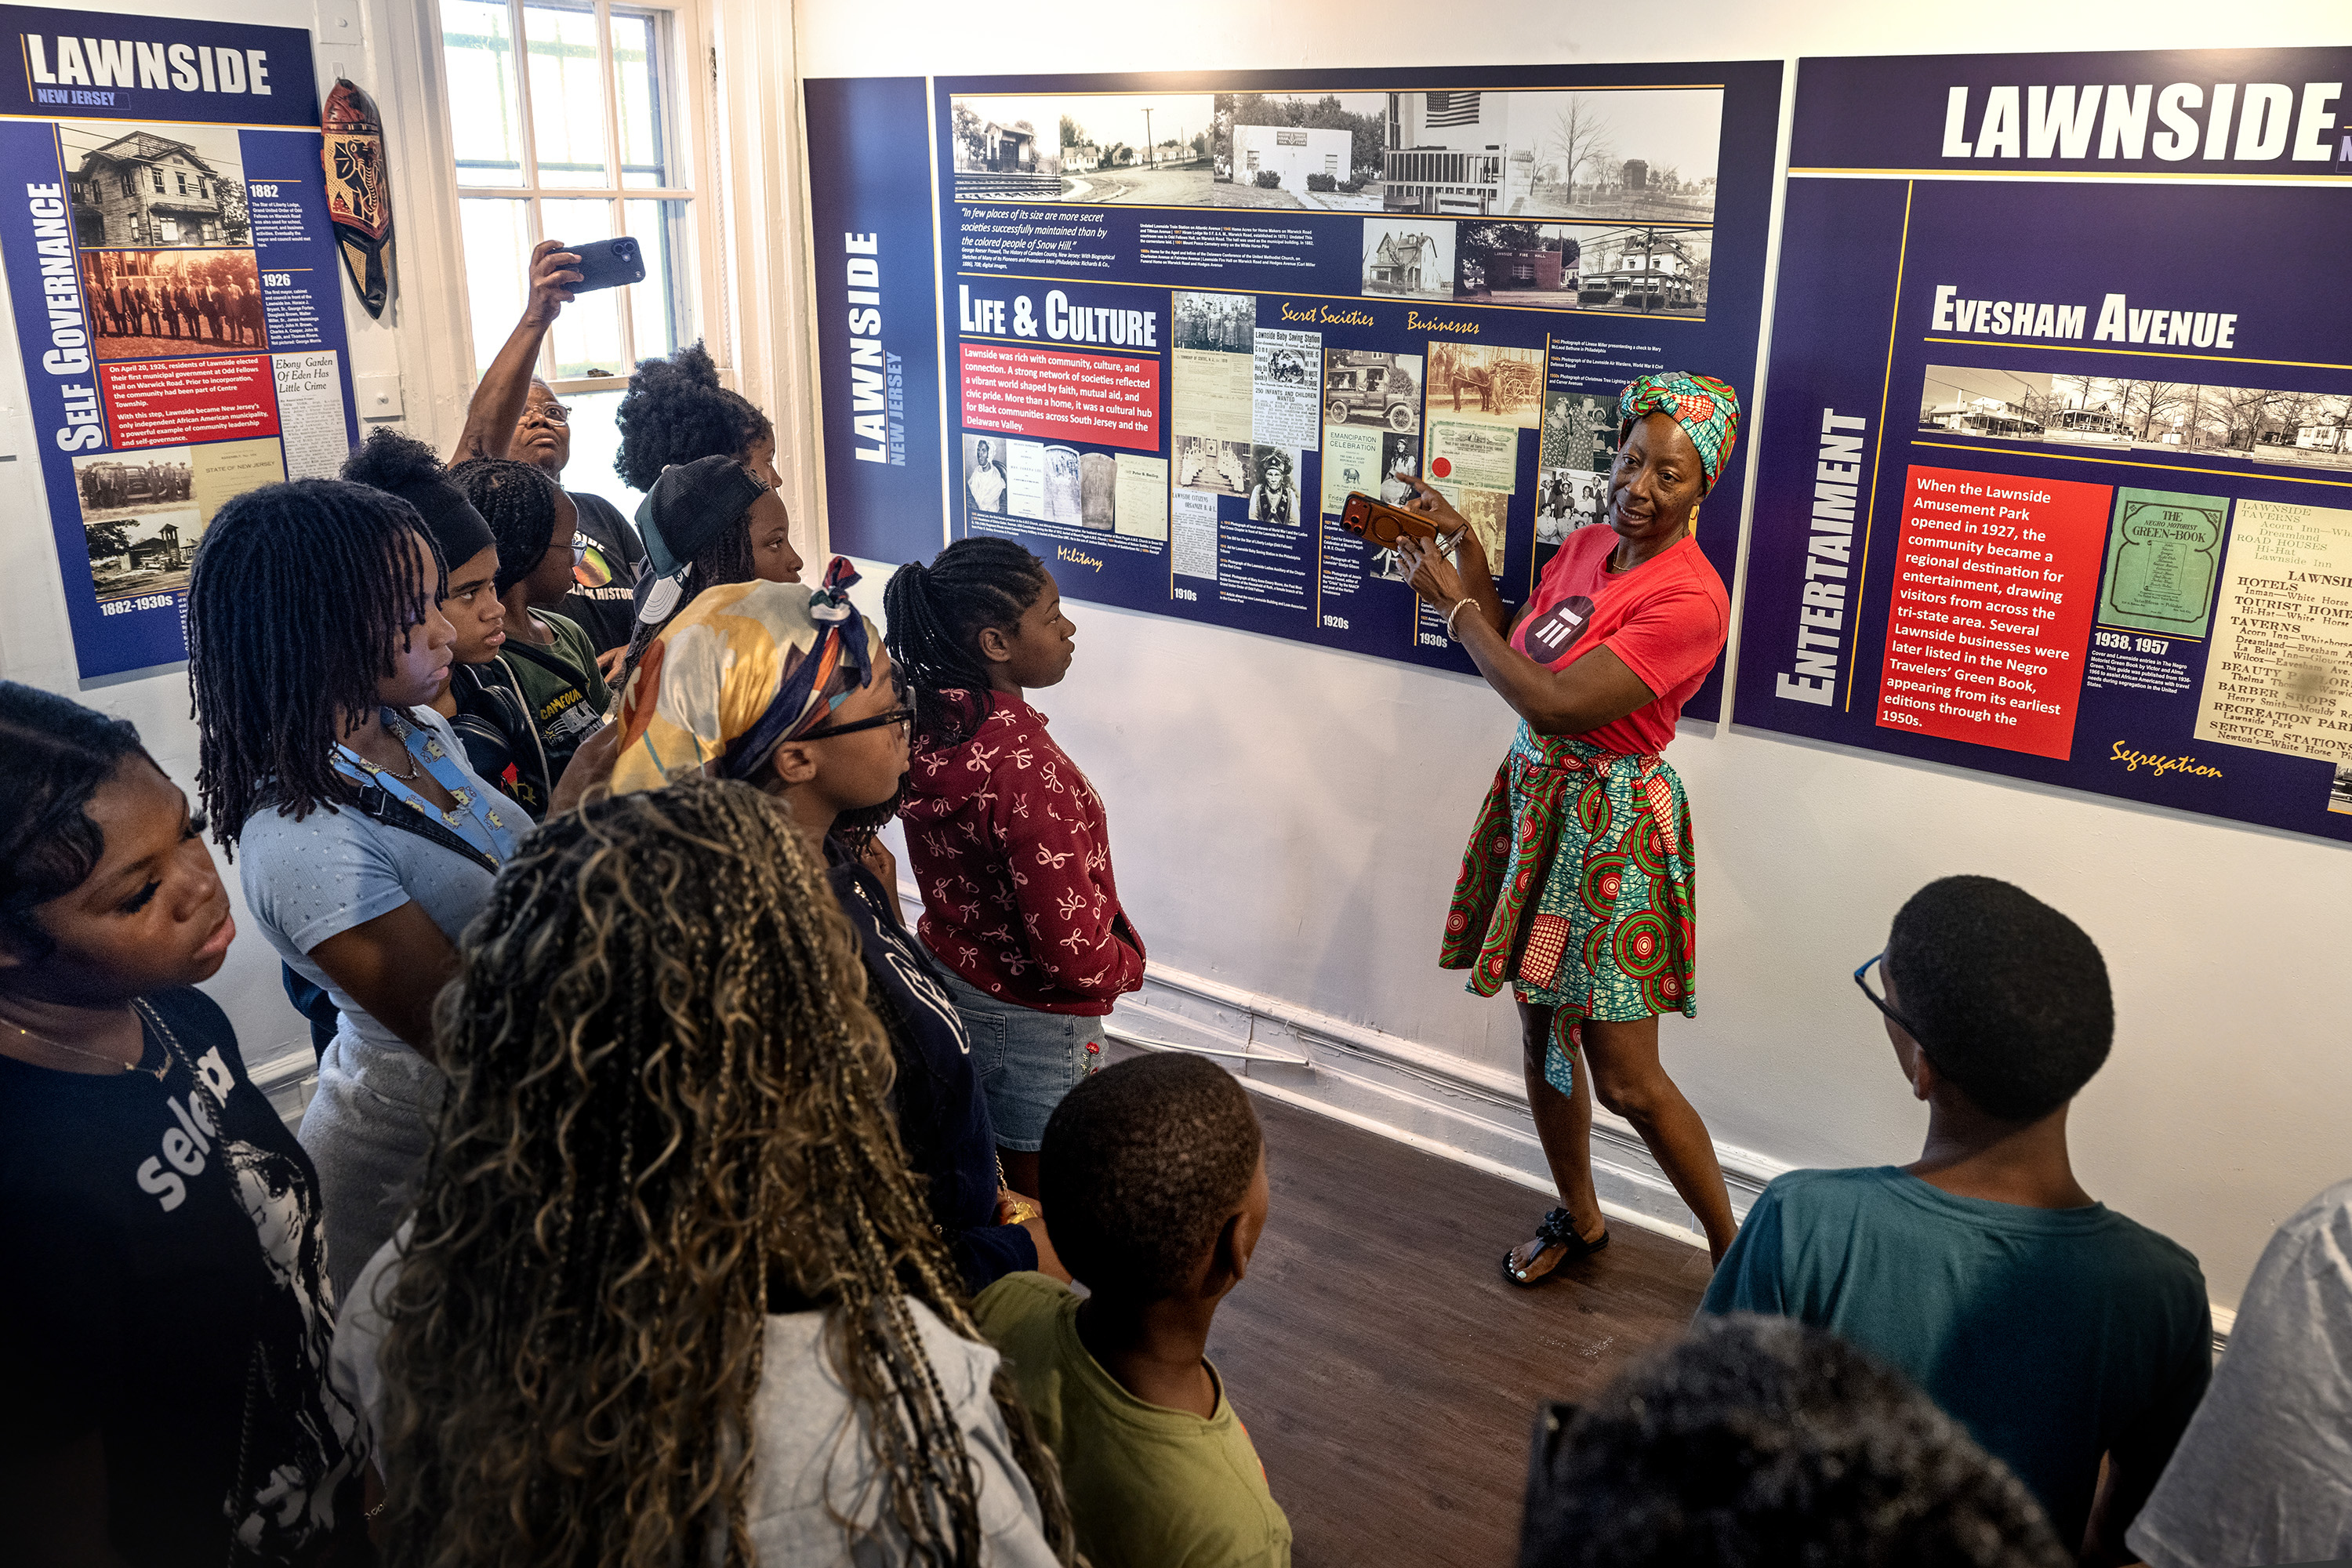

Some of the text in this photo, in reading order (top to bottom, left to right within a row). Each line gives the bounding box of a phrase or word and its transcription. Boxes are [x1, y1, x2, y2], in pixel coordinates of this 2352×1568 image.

[27, 34, 272, 95] LAWNSIDE
[38, 89, 115, 107] NEW JERSEY
[1942, 82, 2342, 162] LAWNSIDE
[249, 184, 279, 198] 1882
[971, 208, 985, 219] few
[985, 209, 1009, 220] places
[1010, 209, 1020, 220] of
[1019, 210, 1029, 219] its
[1029, 210, 1044, 220] size
[1080, 213, 1104, 222] secret
[27, 183, 89, 375] GOVERNANCE
[262, 274, 291, 287] 1926
[959, 284, 1156, 347] LIFE & CULTURE
[1281, 303, 1374, 327] Secret Societies
[1406, 311, 1479, 334] Businesses
[1932, 285, 2238, 348] EVESHAM AVENUE
[845, 232, 886, 464] LAWNSIDE
[1277, 332, 1287, 342] Baby
[1289, 333, 1303, 343] Saving
[275, 358, 332, 371] Ebony Garden
[964, 348, 997, 359] Lawnside
[1014, 352, 1028, 361] rich
[1029, 354, 1046, 364] with
[1047, 358, 1091, 370] community,
[1094, 361, 1123, 372] culture,
[1124, 364, 1139, 372] and
[278, 369, 328, 382] Of Eden Has
[279, 381, 326, 393] Little Crime
[965, 363, 1149, 388] connection. A strong network of societies reflected
[56, 384, 103, 452] SELF
[887, 351, 906, 466] NEW JERSEY
[1330, 432, 1376, 443] EMANCIPATION
[1330, 441, 1376, 452] CELEBRATION
[1917, 478, 2050, 503] When the Lawnside
[1913, 497, 2029, 521] Amusement Park
[2162, 510, 2183, 522] THE
[2242, 502, 2311, 516] LAWNSIDE
[2242, 510, 2300, 523] TAVERNS
[1911, 517, 2045, 541] opened in 1927, the
[2132, 526, 2207, 543] GREEN-BOOK
[2144, 520, 2198, 531] NEGRO MOTORIST
[1908, 536, 2053, 561] community became a
[2237, 535, 2328, 550] ROAD HOUSES
[1058, 545, 1103, 572] Military
[1776, 408, 1866, 706] ENTERTAIMENT
[1906, 554, 2063, 582] regional destination for
[1174, 588, 1197, 601] 1910s
[1903, 572, 2063, 604] entertainment, drawing
[2238, 577, 2298, 591] HOTELS
[100, 594, 173, 616] 1882-1930s
[1900, 588, 2055, 619] visitors from across the
[2234, 596, 2301, 612] TOURIST
[1323, 615, 1348, 629] 1920s
[1897, 606, 2039, 636] tri-state area. Several
[2230, 616, 2300, 633] TAVERNS
[1419, 632, 1447, 648] 1930s
[1895, 623, 2069, 659] Lawnside businesses were
[2095, 632, 2169, 655] 1938, 1957
[1893, 640, 2047, 675] later listed in the Negro
[1955, 670, 1994, 685] Green
[1998, 676, 2036, 694] Book,
[1887, 678, 2060, 714] appearing from its earliest
[2218, 682, 2336, 706] BARBER SHOPS
[1882, 710, 1922, 726] 1950s.
[1885, 694, 2016, 725] editions through the
[2213, 702, 2312, 724] RECREATION
[2210, 721, 2274, 739] SERVICE
[2110, 740, 2223, 779] Segregation
